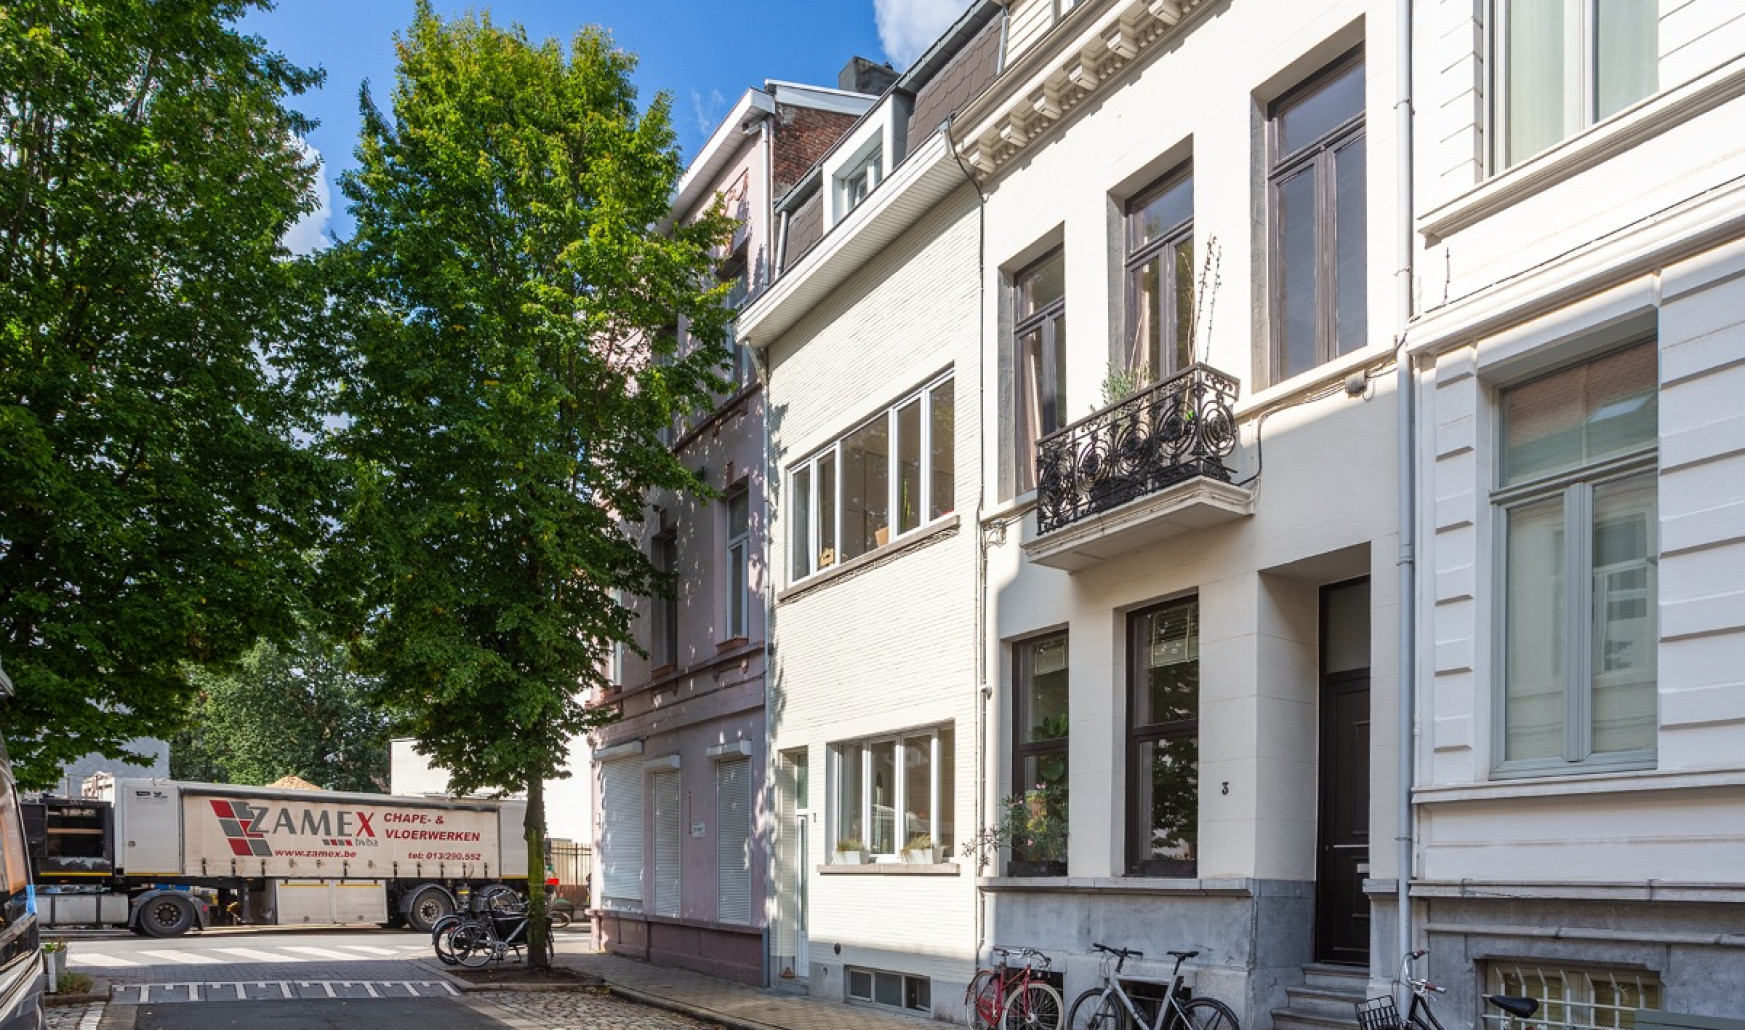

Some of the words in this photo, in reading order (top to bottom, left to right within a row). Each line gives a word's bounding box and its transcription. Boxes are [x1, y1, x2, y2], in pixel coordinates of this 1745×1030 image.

[1221, 780, 1230, 796] 3
[246, 805, 376, 838] ZAMEX
[383, 812, 432, 824] CHAPE-
[435, 815, 444, 825] &
[385, 829, 481, 842] VLOERWERKEN
[355, 838, 379, 848] bvba
[274, 849, 357, 858] www.zamex.be
